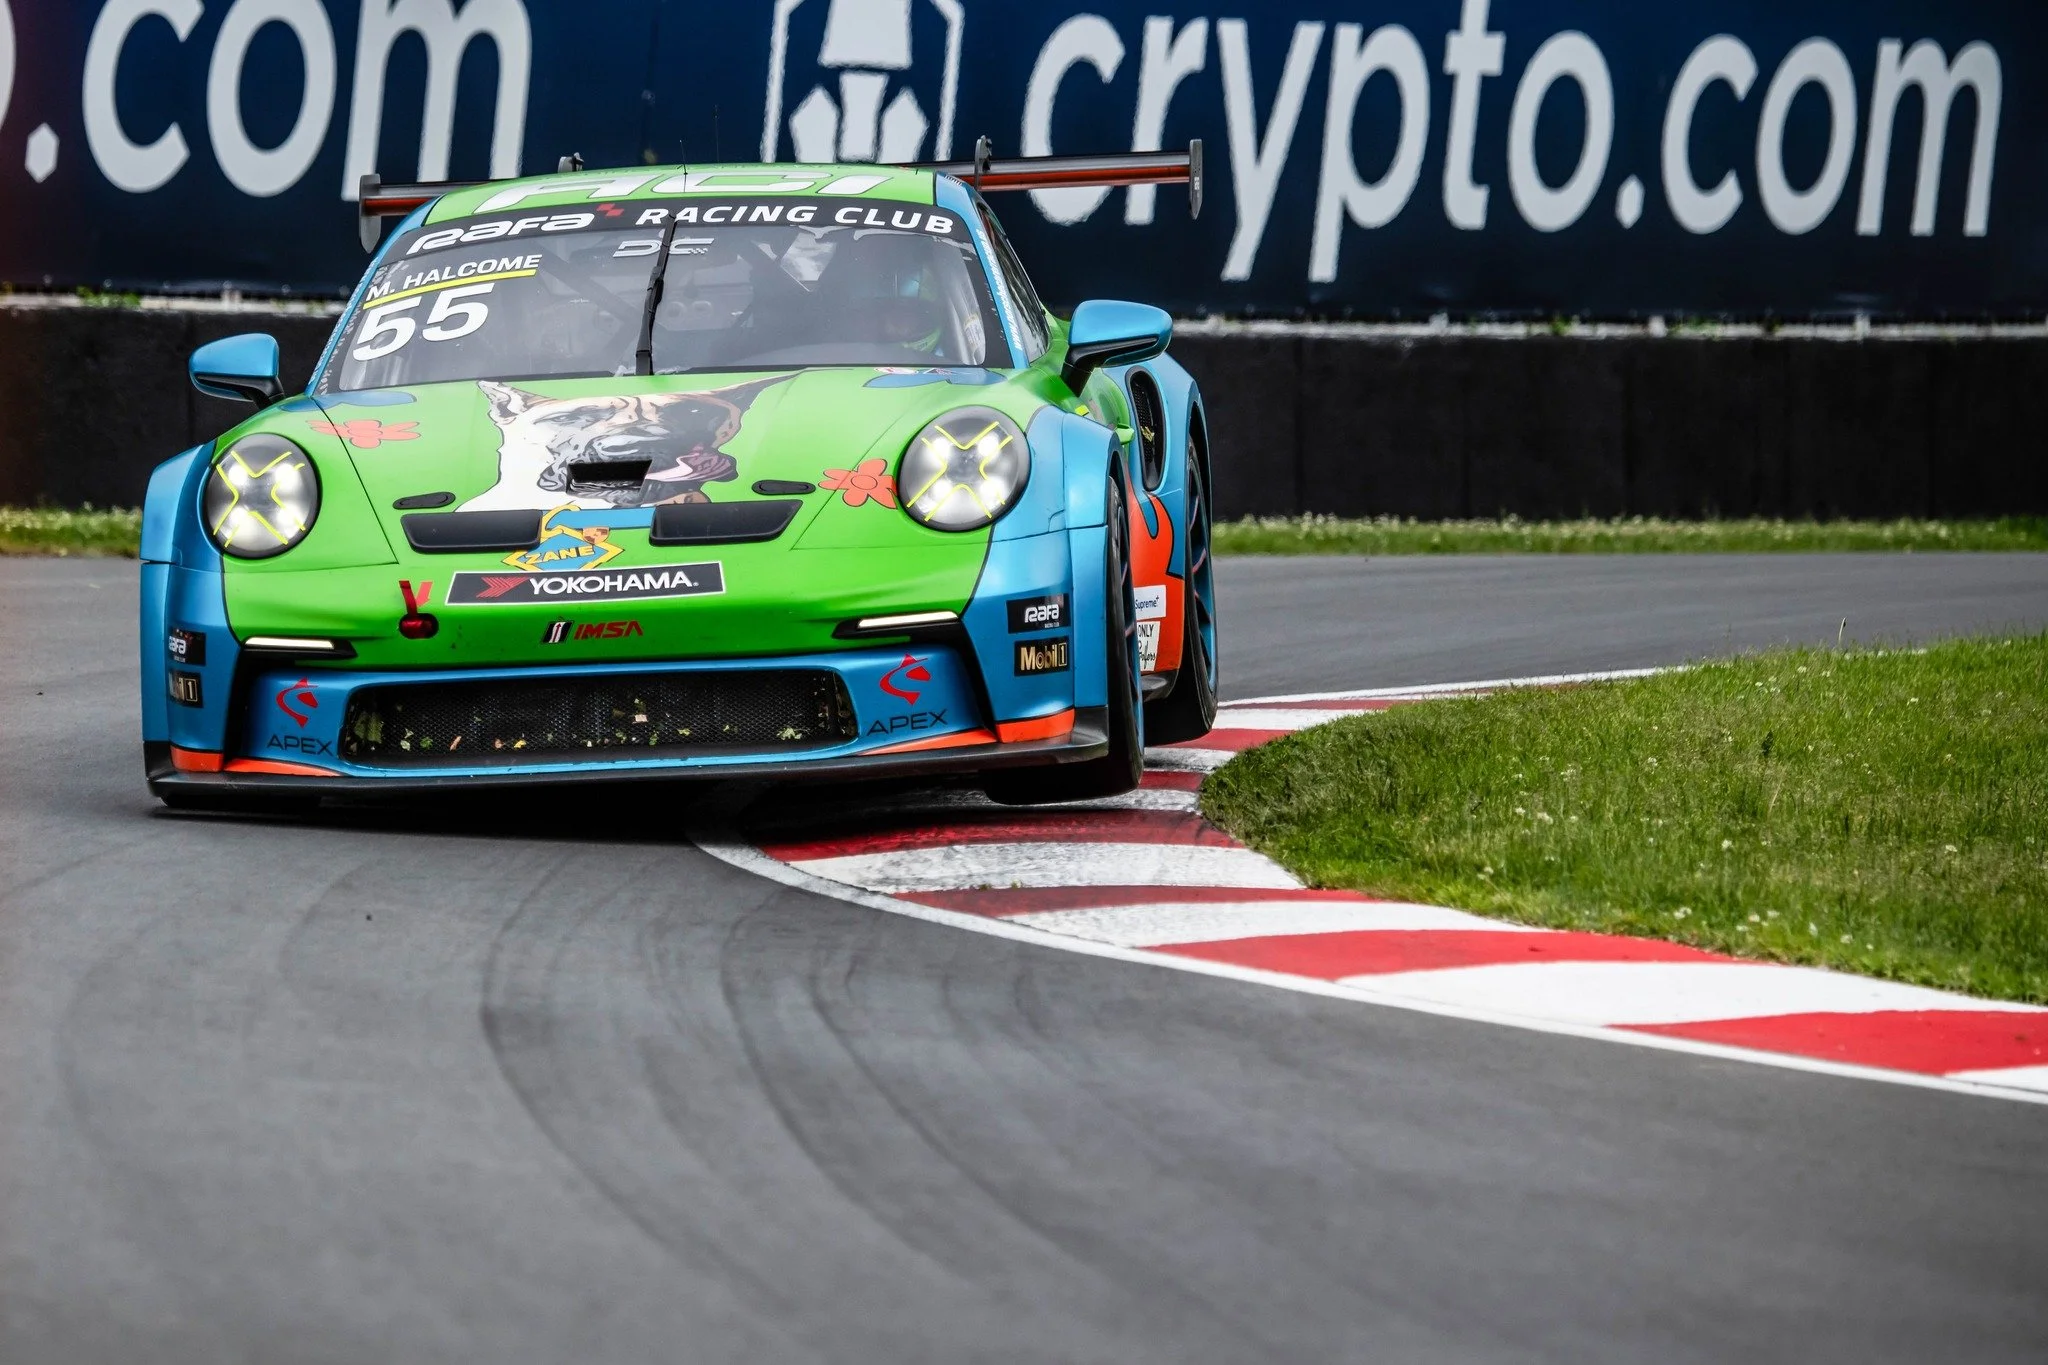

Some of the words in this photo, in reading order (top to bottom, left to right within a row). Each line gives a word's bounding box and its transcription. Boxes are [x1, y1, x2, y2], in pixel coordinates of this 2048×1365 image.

[0, 0, 533, 201] .com
[1020, 0, 2002, 284] crypto.com
[635, 205, 817, 227] RACING
[834, 206, 955, 235] CLUB
[365, 285, 396, 302] M.
[402, 254, 543, 290] HALCOME
[352, 282, 496, 362] 55
[524, 545, 596, 566] ZANE
[530, 571, 694, 596] YOKOHAMA
[573, 620, 644, 640] IMSA
[1020, 644, 1058, 671] Mobil
[866, 708, 949, 737] APEX
[266, 733, 335, 758] APEX
